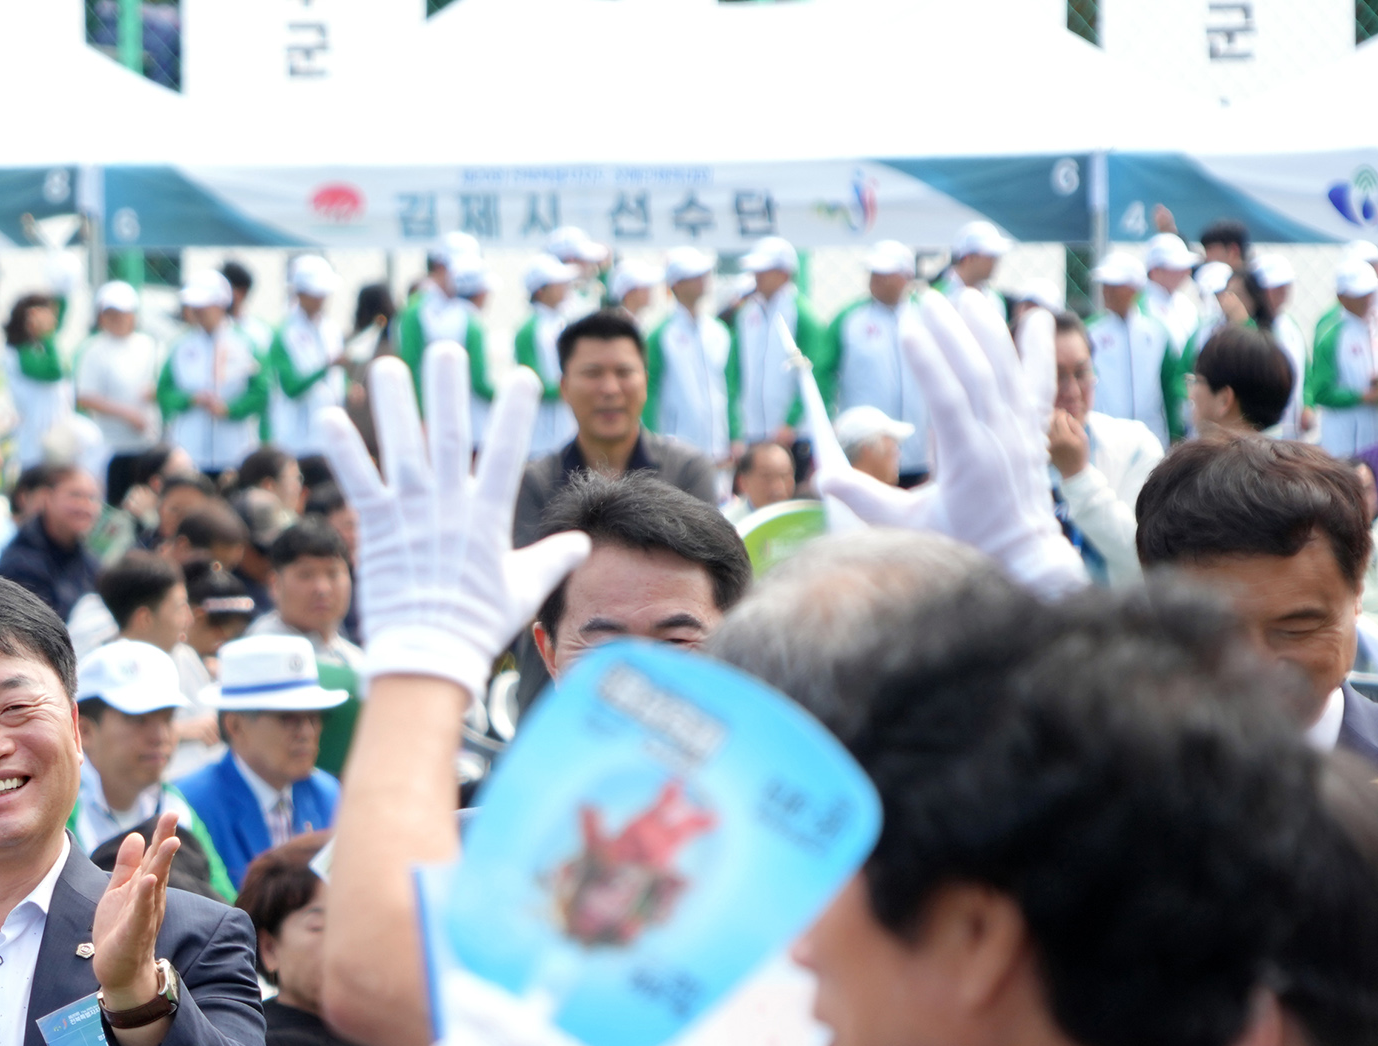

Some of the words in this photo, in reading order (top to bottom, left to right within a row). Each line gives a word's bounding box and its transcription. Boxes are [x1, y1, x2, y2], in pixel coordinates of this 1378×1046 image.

[1049, 157, 1080, 196] 6
[395, 190, 562, 240] 김제시
[609, 189, 780, 239] 선수단
[1121, 200, 1149, 237] 4
